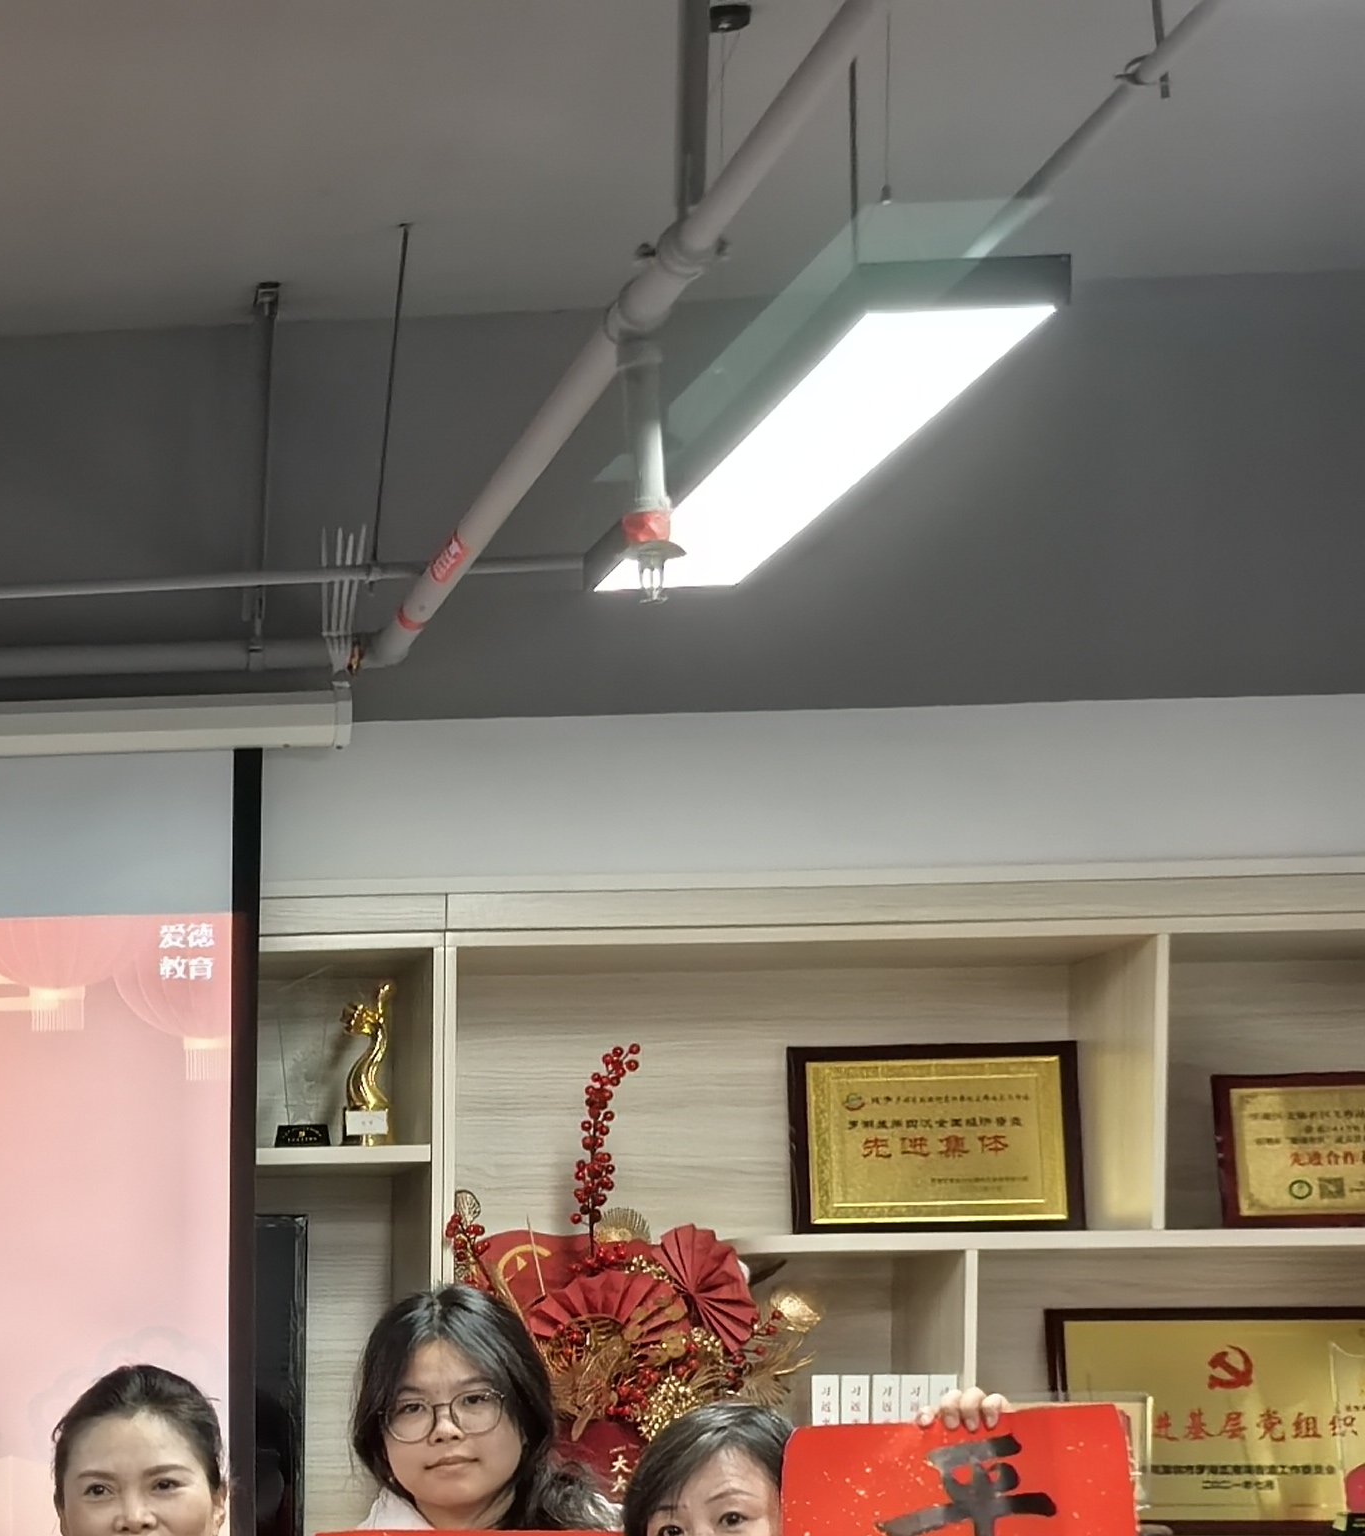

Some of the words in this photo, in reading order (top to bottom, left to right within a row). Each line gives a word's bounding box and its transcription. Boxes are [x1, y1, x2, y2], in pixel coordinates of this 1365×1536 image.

[158, 922, 215, 949] 爱德
[158, 955, 215, 981] 教育
[862, 1134, 1009, 1159] 先进集体
